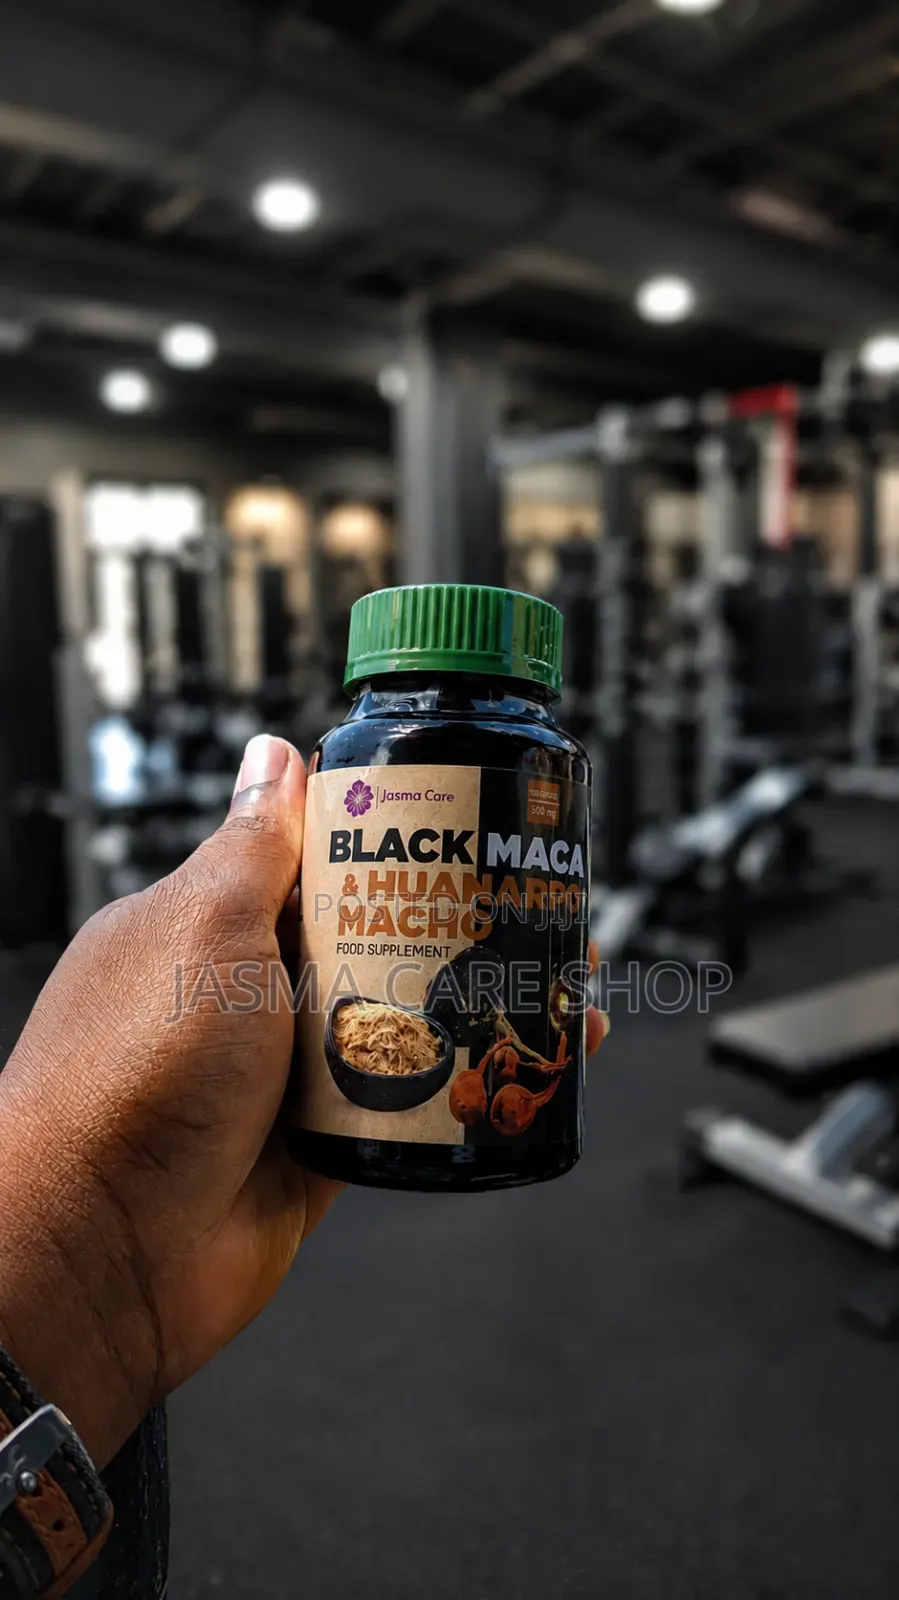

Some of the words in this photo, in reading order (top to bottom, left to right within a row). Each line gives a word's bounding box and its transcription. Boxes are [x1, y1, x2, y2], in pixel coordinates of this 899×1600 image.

[380, 789, 421, 803] Jasma
[425, 789, 454, 803] Care
[531, 805, 545, 816] 500
[328, 828, 476, 864] BLACK
[487, 832, 585, 878] MACA
[342, 873, 359, 897] &
[337, 904, 493, 941] MACHO
[336, 942, 365, 956] FOOD
[367, 943, 451, 959] SUPPLEMENT
